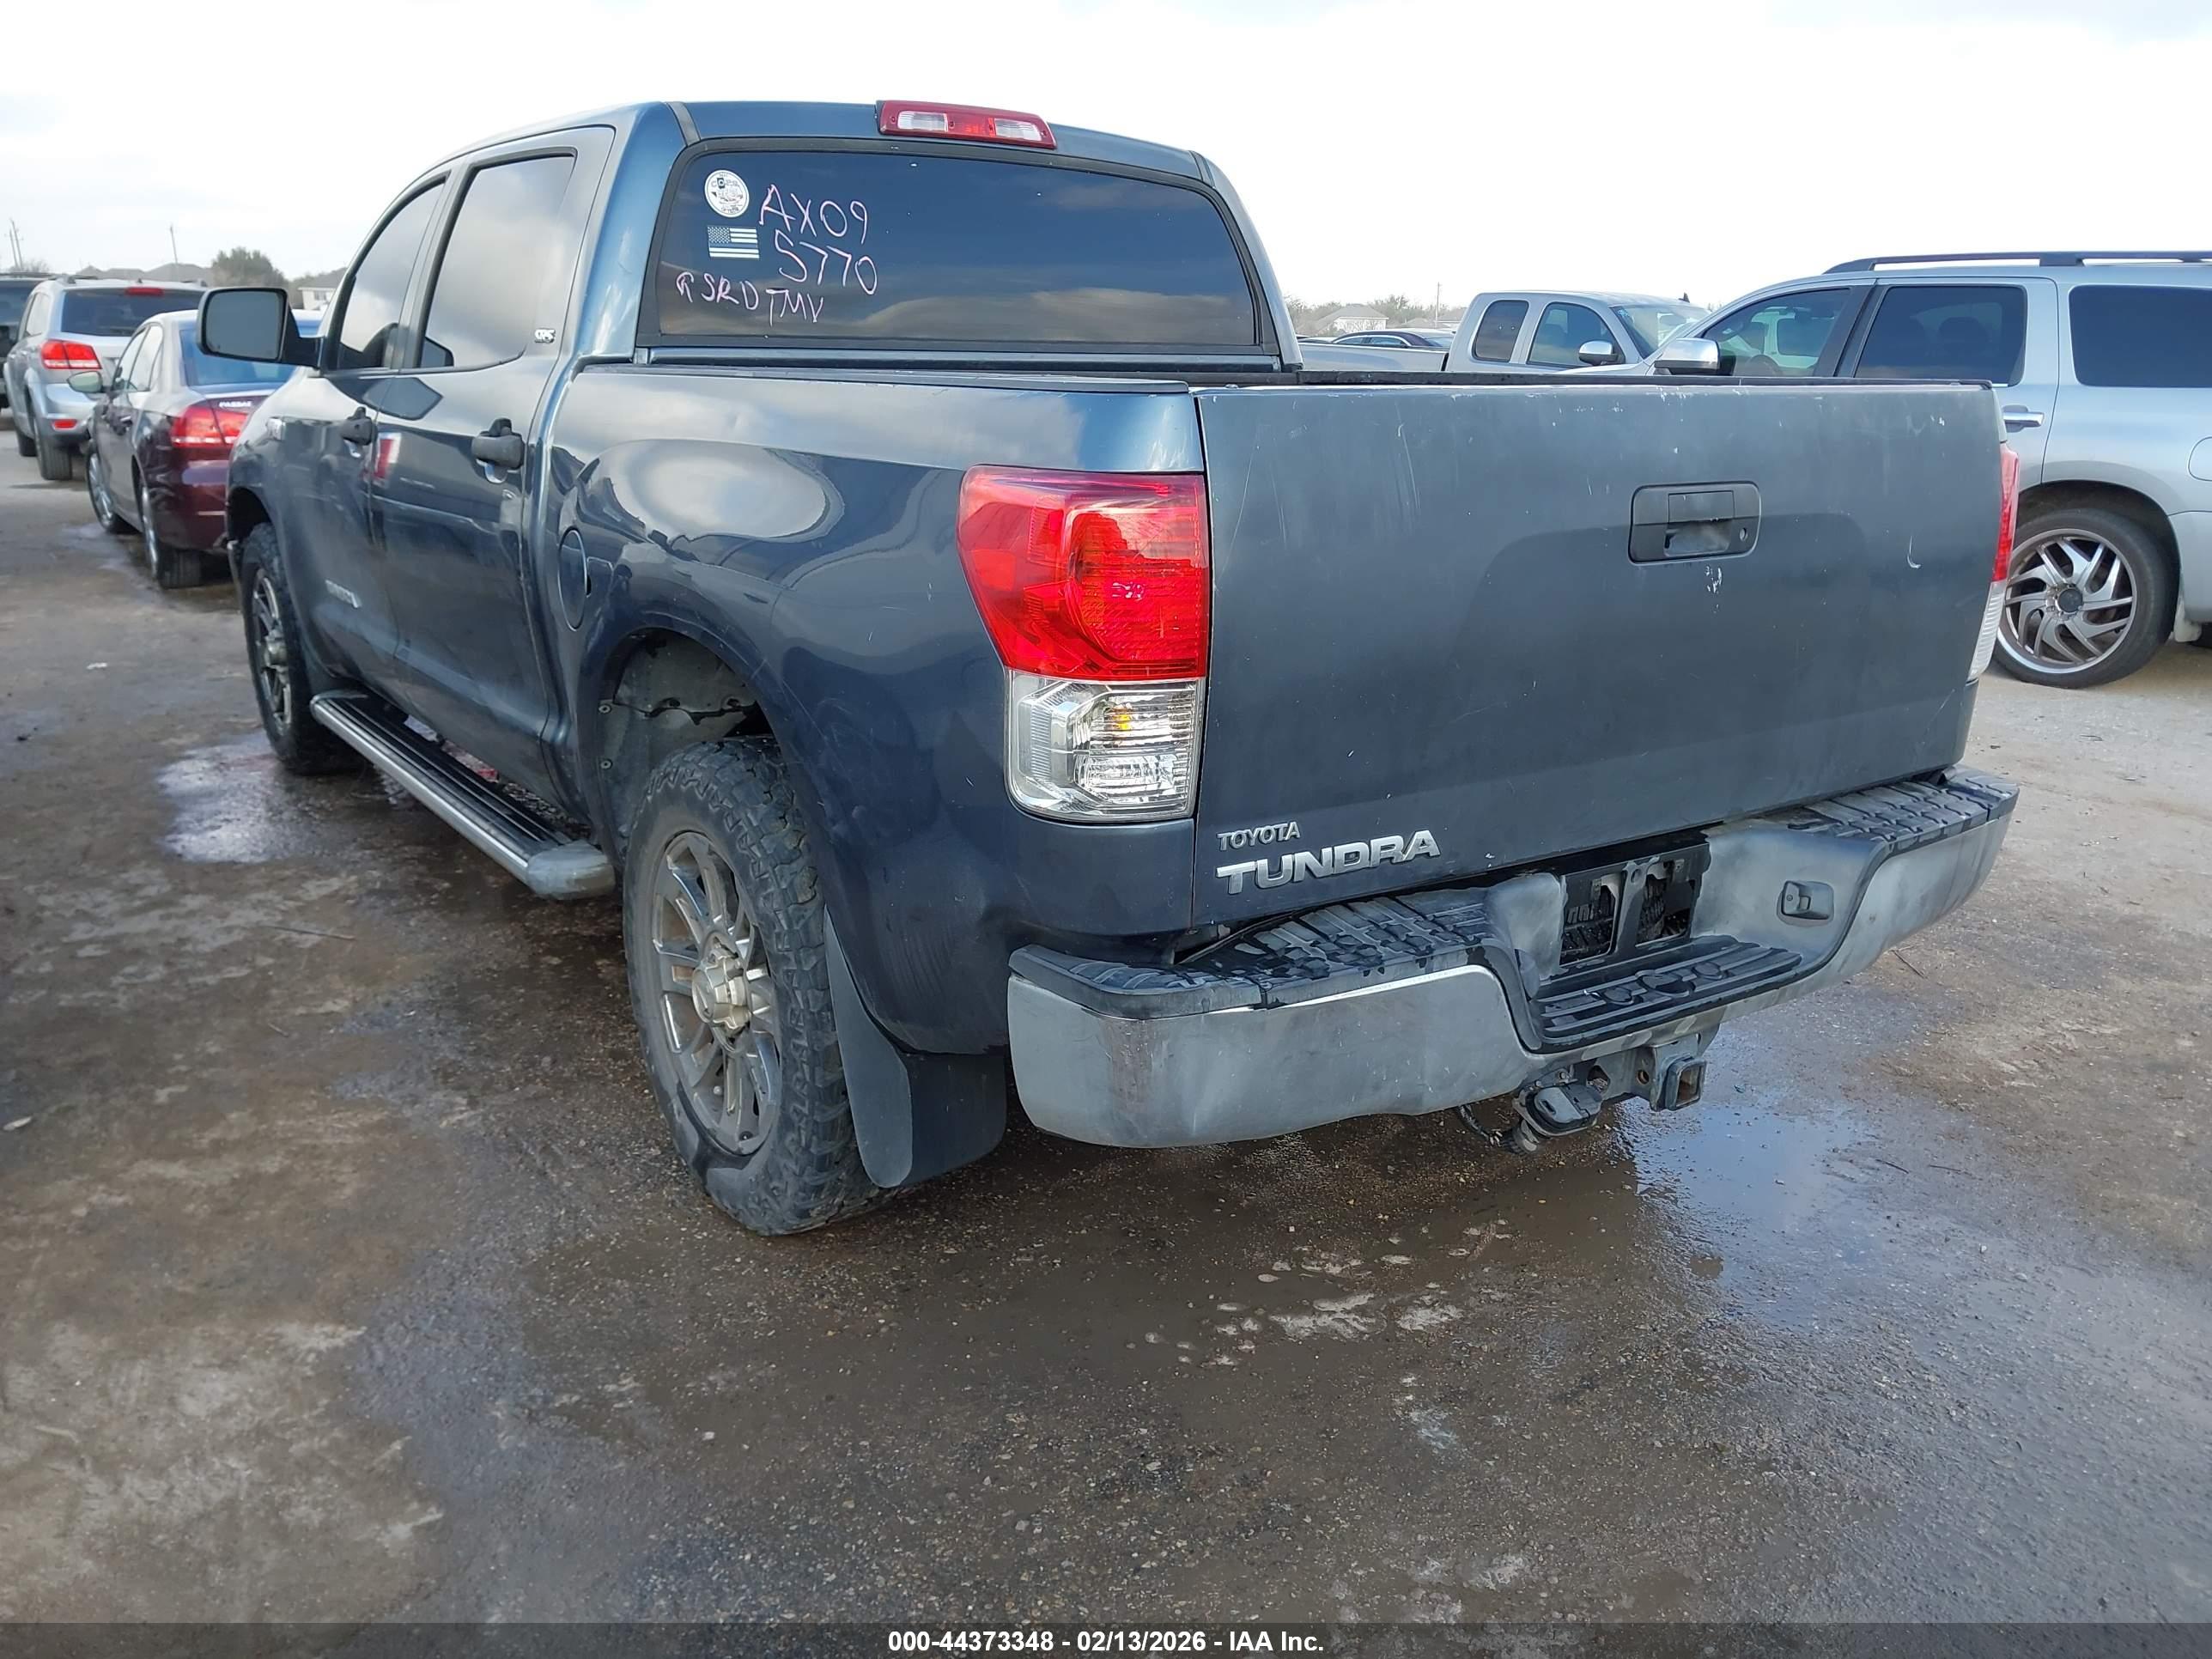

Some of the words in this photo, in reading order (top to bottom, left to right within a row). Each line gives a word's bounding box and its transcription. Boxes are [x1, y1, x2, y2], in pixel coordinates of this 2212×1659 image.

[759, 184, 868, 245] AX09
[1216, 830, 1440, 895] TUNDRA
[1217, 822, 1300, 851] TOYOTA
